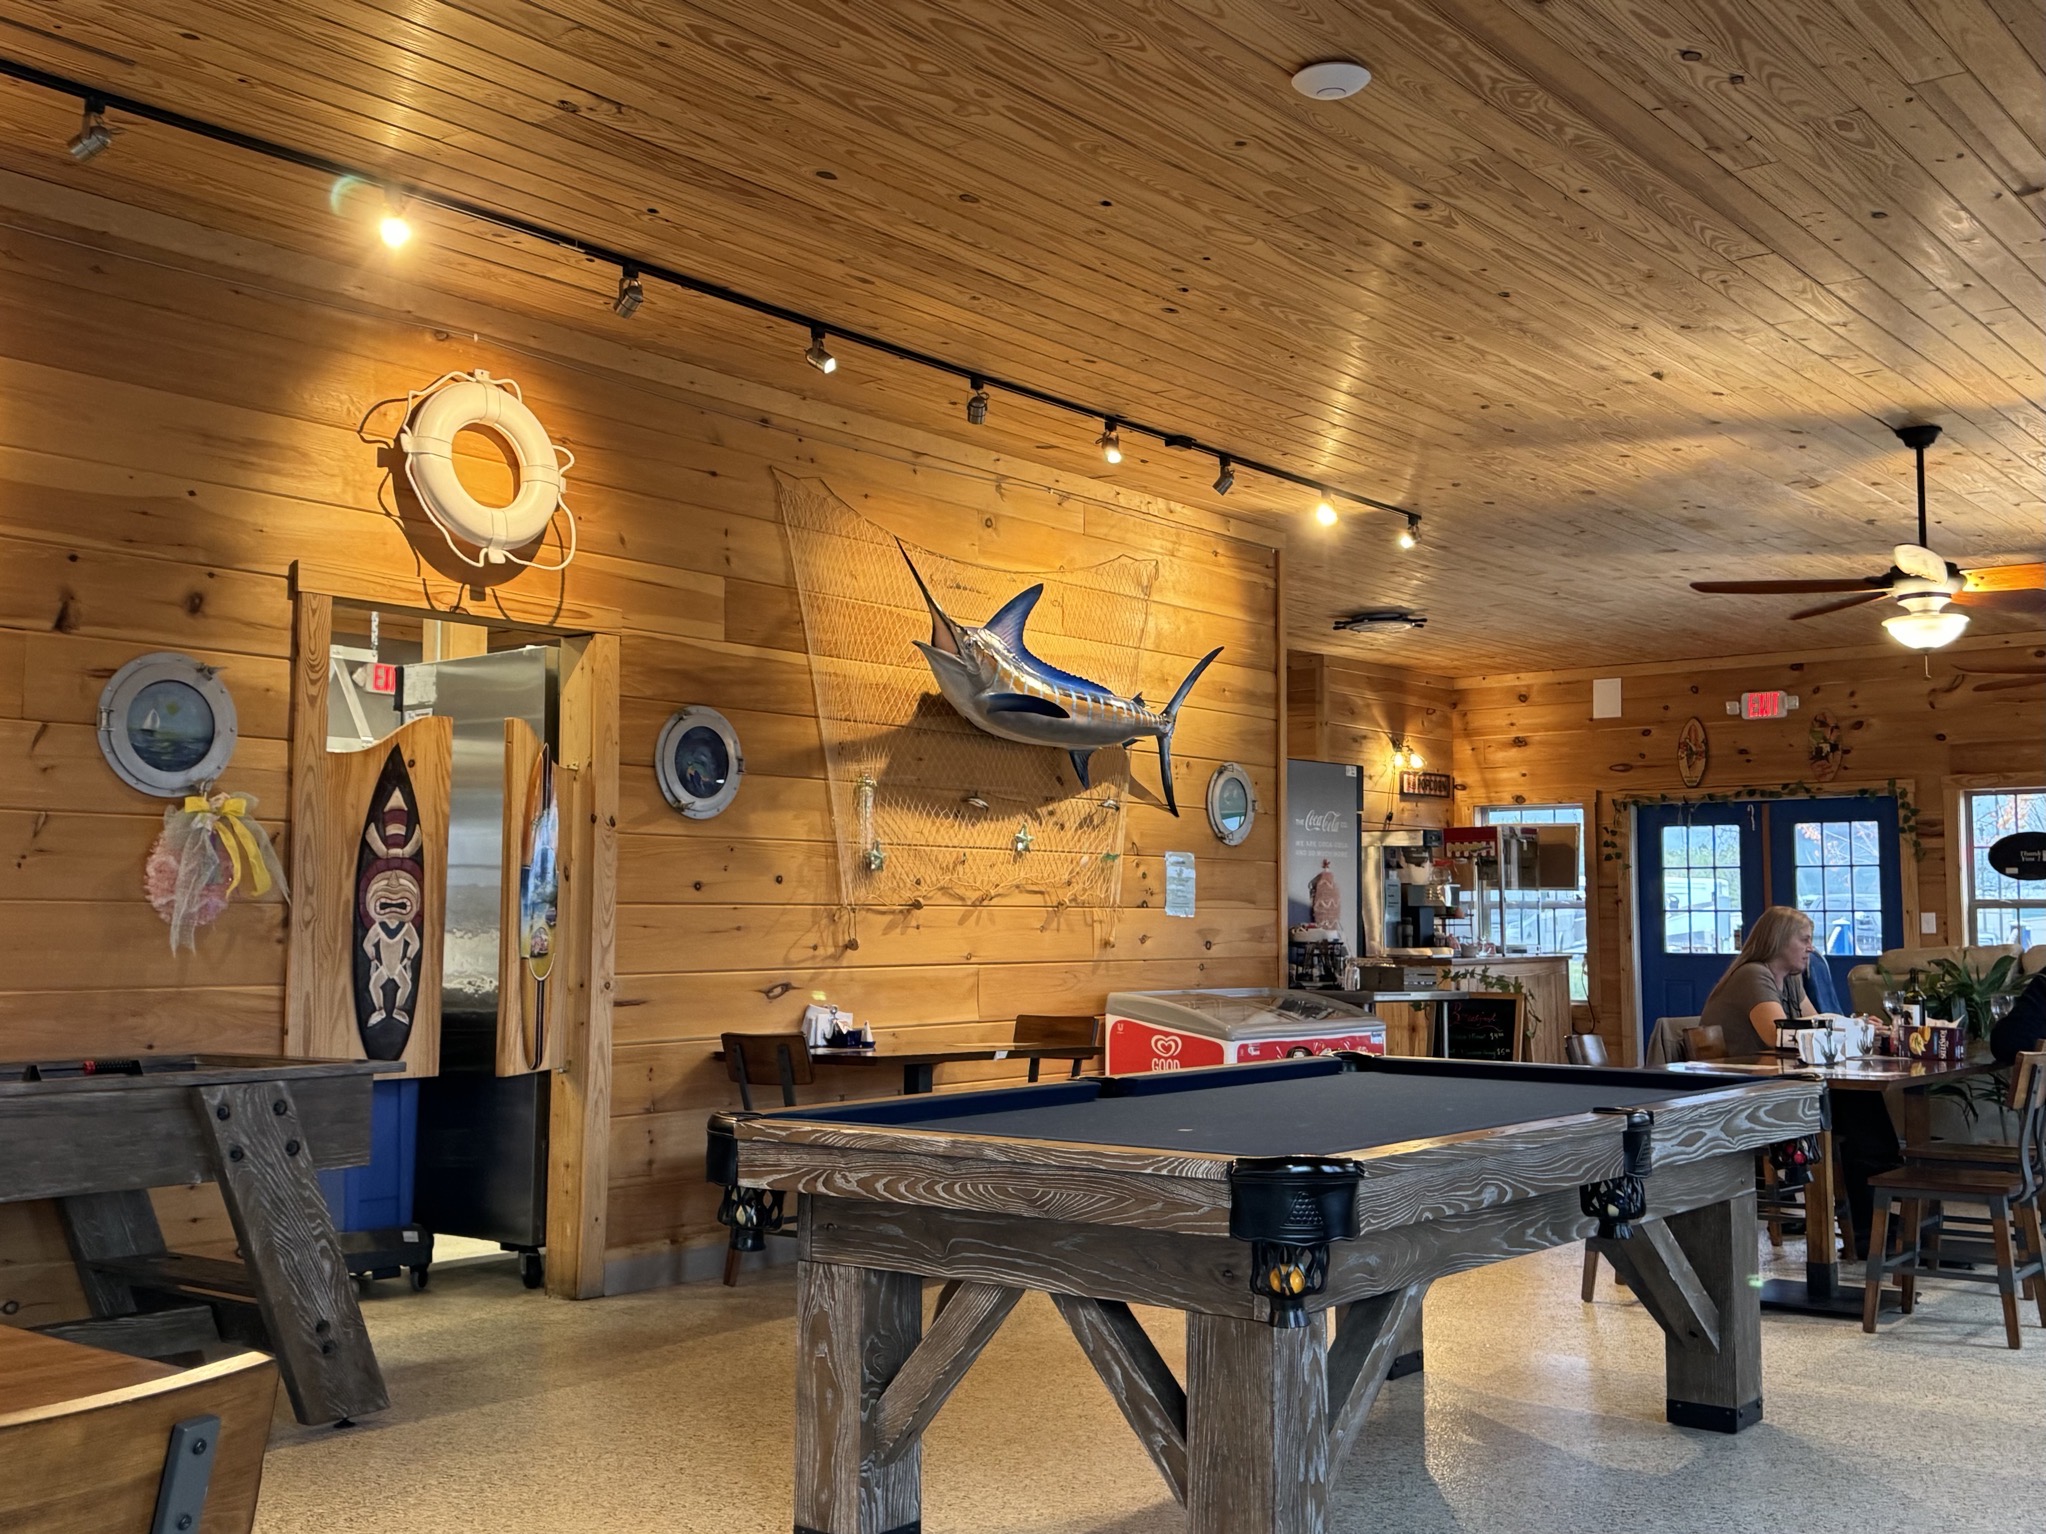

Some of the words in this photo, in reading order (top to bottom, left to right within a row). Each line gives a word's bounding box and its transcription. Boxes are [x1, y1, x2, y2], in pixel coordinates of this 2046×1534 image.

[1748, 691, 1779, 717] EXIT
[1417, 778, 1449, 792] POPCORN
[1151, 1057, 1181, 1073] GOOD
